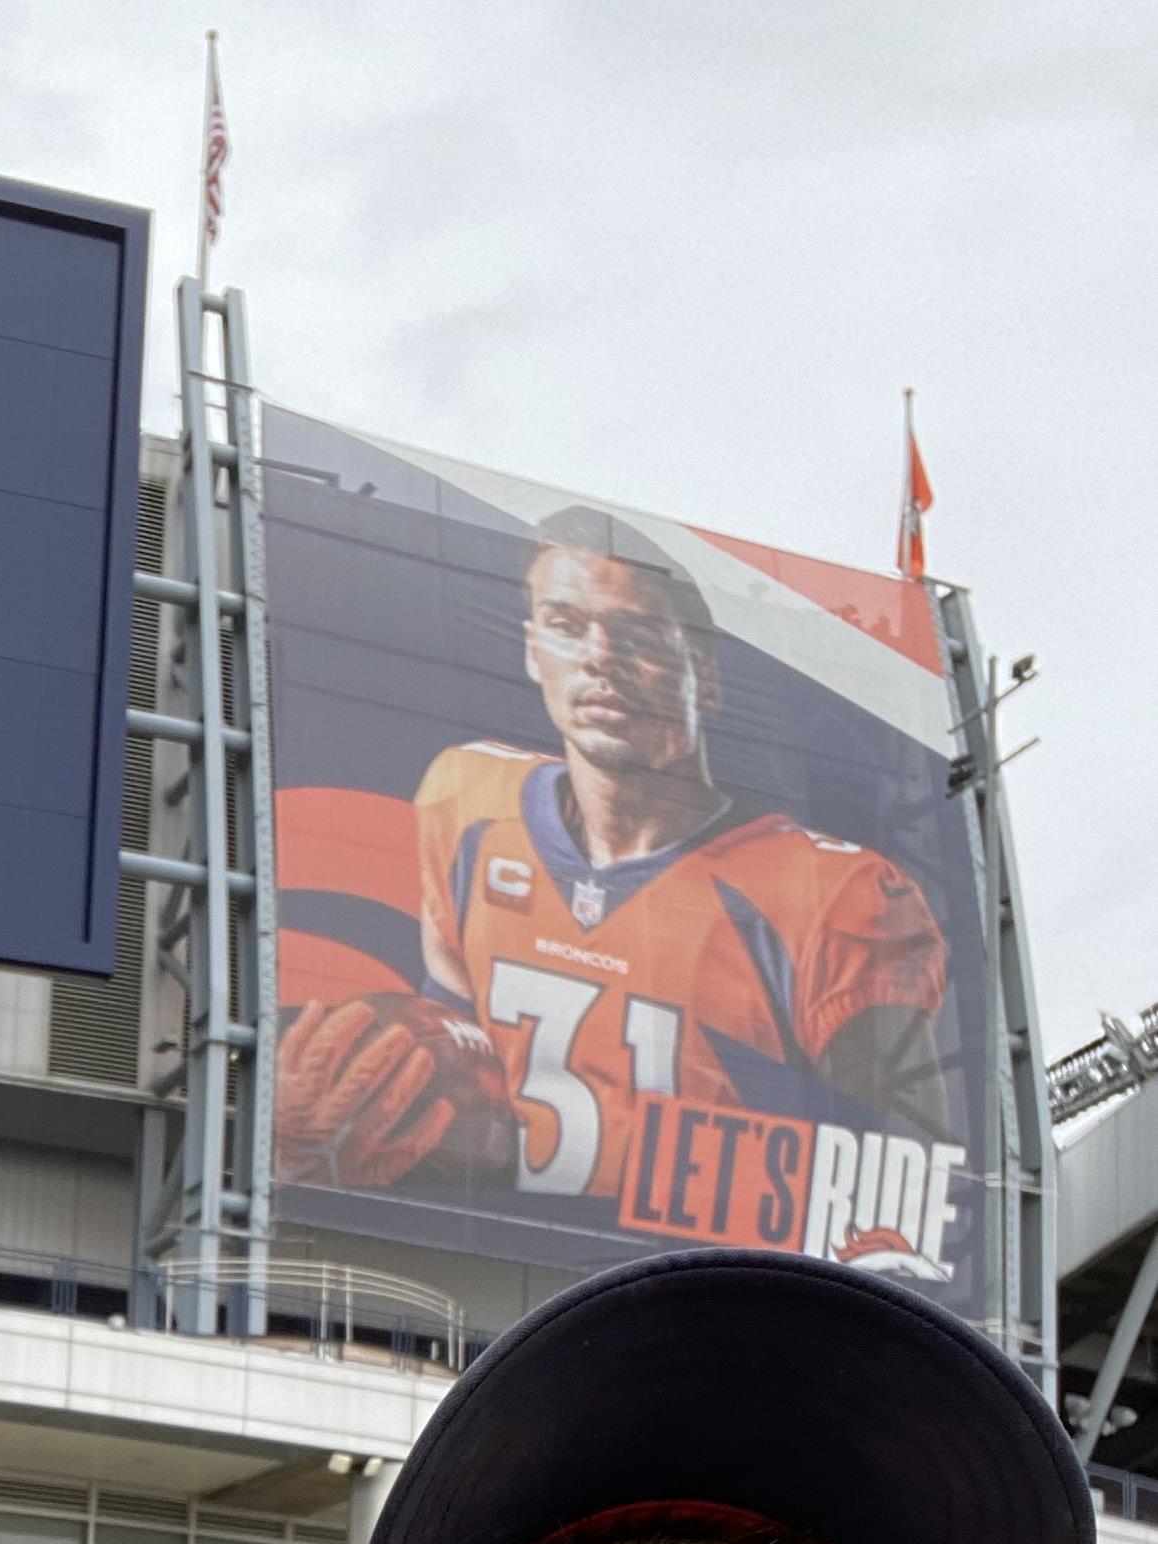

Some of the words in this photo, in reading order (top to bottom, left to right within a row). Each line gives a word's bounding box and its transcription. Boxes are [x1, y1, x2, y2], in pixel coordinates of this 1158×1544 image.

[535, 938, 629, 975] BRONCOS
[633, 1102, 800, 1243] LET'S
[804, 1123, 966, 1275] RIDE
